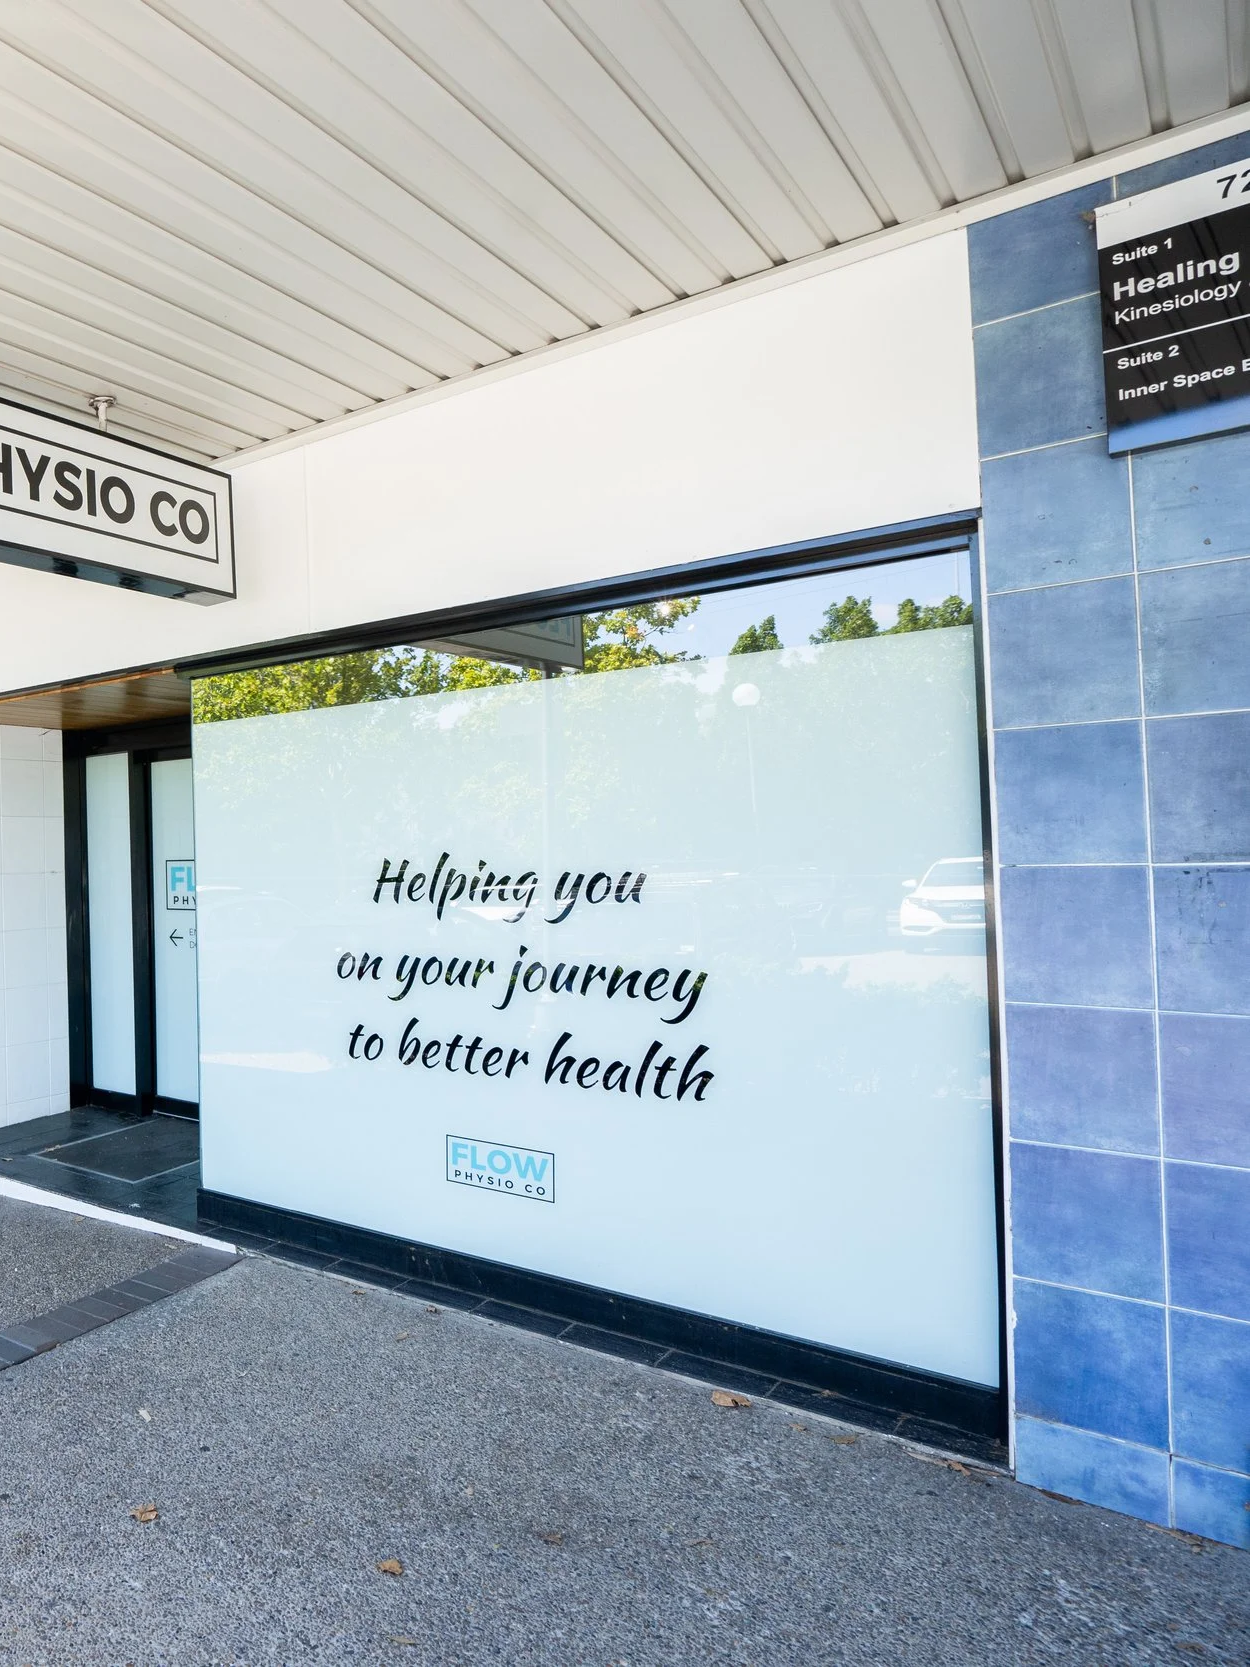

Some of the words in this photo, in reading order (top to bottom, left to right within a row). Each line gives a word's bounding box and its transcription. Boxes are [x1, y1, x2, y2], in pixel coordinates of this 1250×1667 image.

[1112, 244, 1158, 265] Suite
[1163, 237, 1173, 250] 1
[1113, 251, 1240, 301] Healing
[1115, 280, 1242, 325] Kinesiology
[1117, 350, 1163, 370] Suite
[1168, 345, 1180, 357] 2
[1118, 381, 1168, 401] Inner
[1173, 365, 1236, 389] Space
[150, 491, 210, 545] CO
[373, 852, 538, 923] Helping
[544, 871, 648, 924] you
[336, 951, 384, 981] on
[387, 953, 495, 1002] your
[492, 946, 708, 1024] journey
[348, 1023, 384, 1061] to
[398, 1017, 529, 1079] better
[544, 1032, 715, 1102] health
[451, 1142, 549, 1182] FLOW
[454, 1169, 514, 1189] PHYSIO
[525, 1184, 546, 1196] CO
